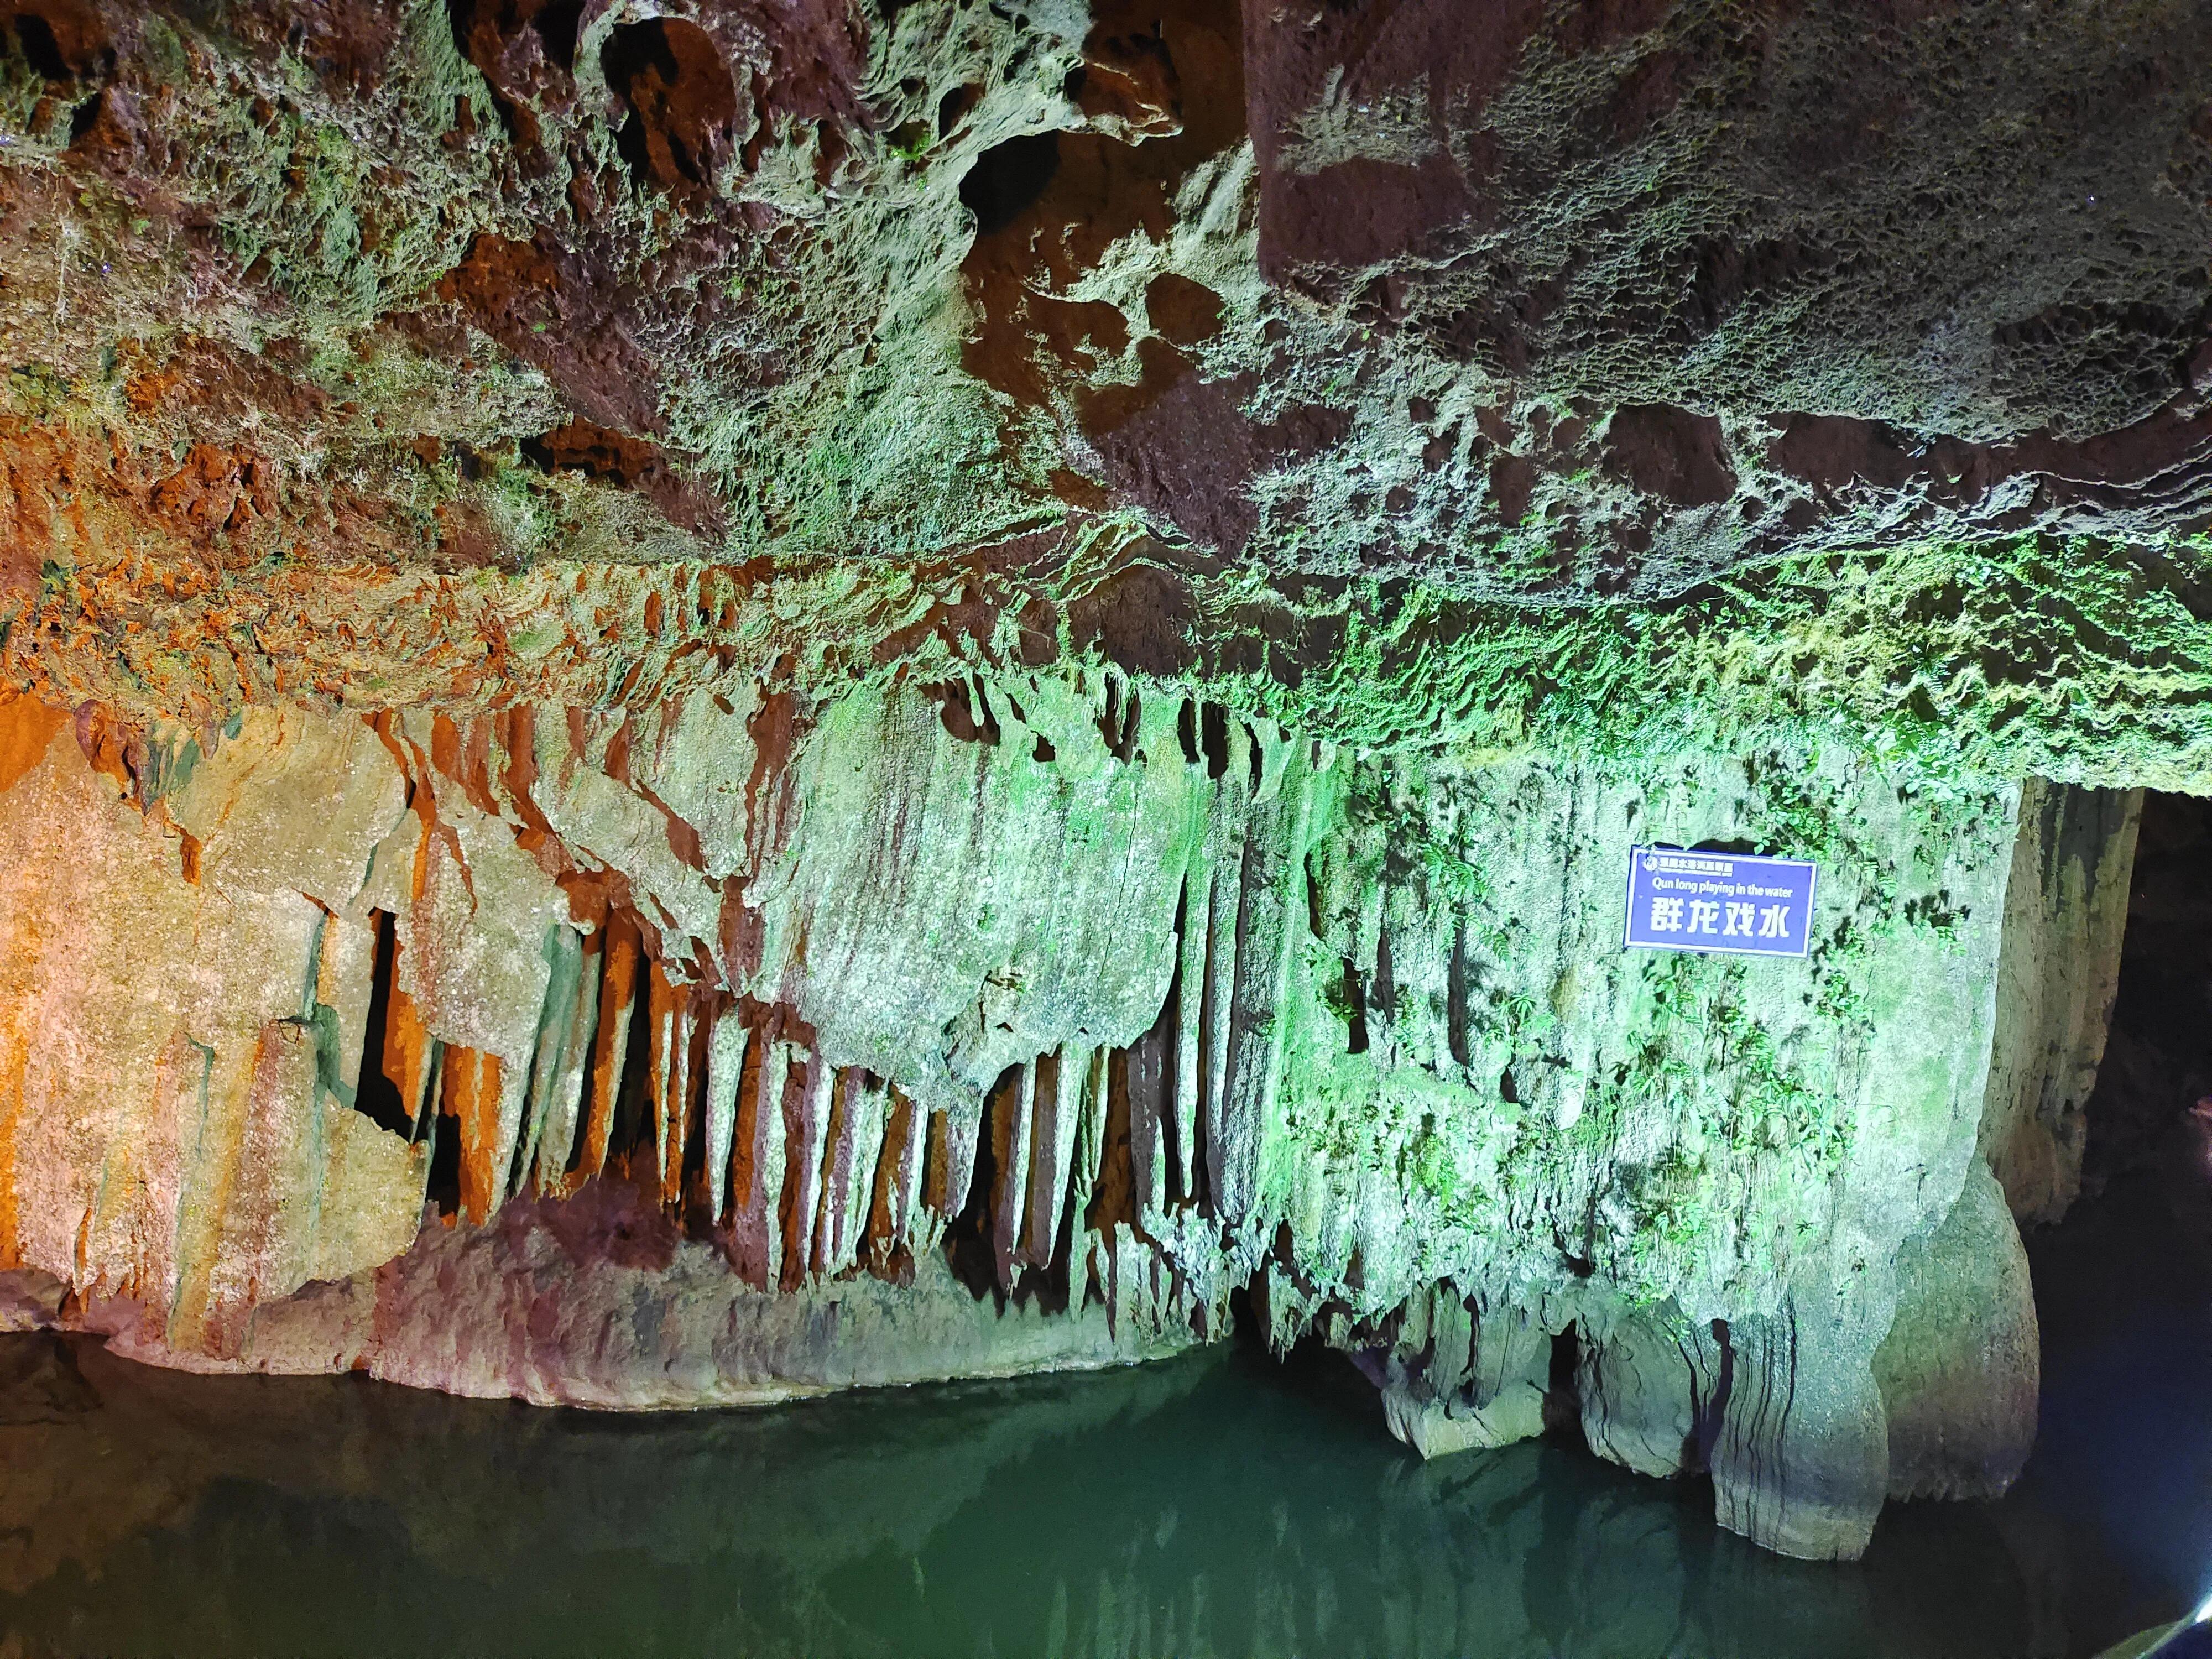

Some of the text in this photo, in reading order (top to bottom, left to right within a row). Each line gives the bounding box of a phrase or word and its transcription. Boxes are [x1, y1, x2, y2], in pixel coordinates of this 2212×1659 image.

[1652, 877, 1793, 898] Qun long playing in the water
[1651, 896, 1790, 938] 群龙戏水
